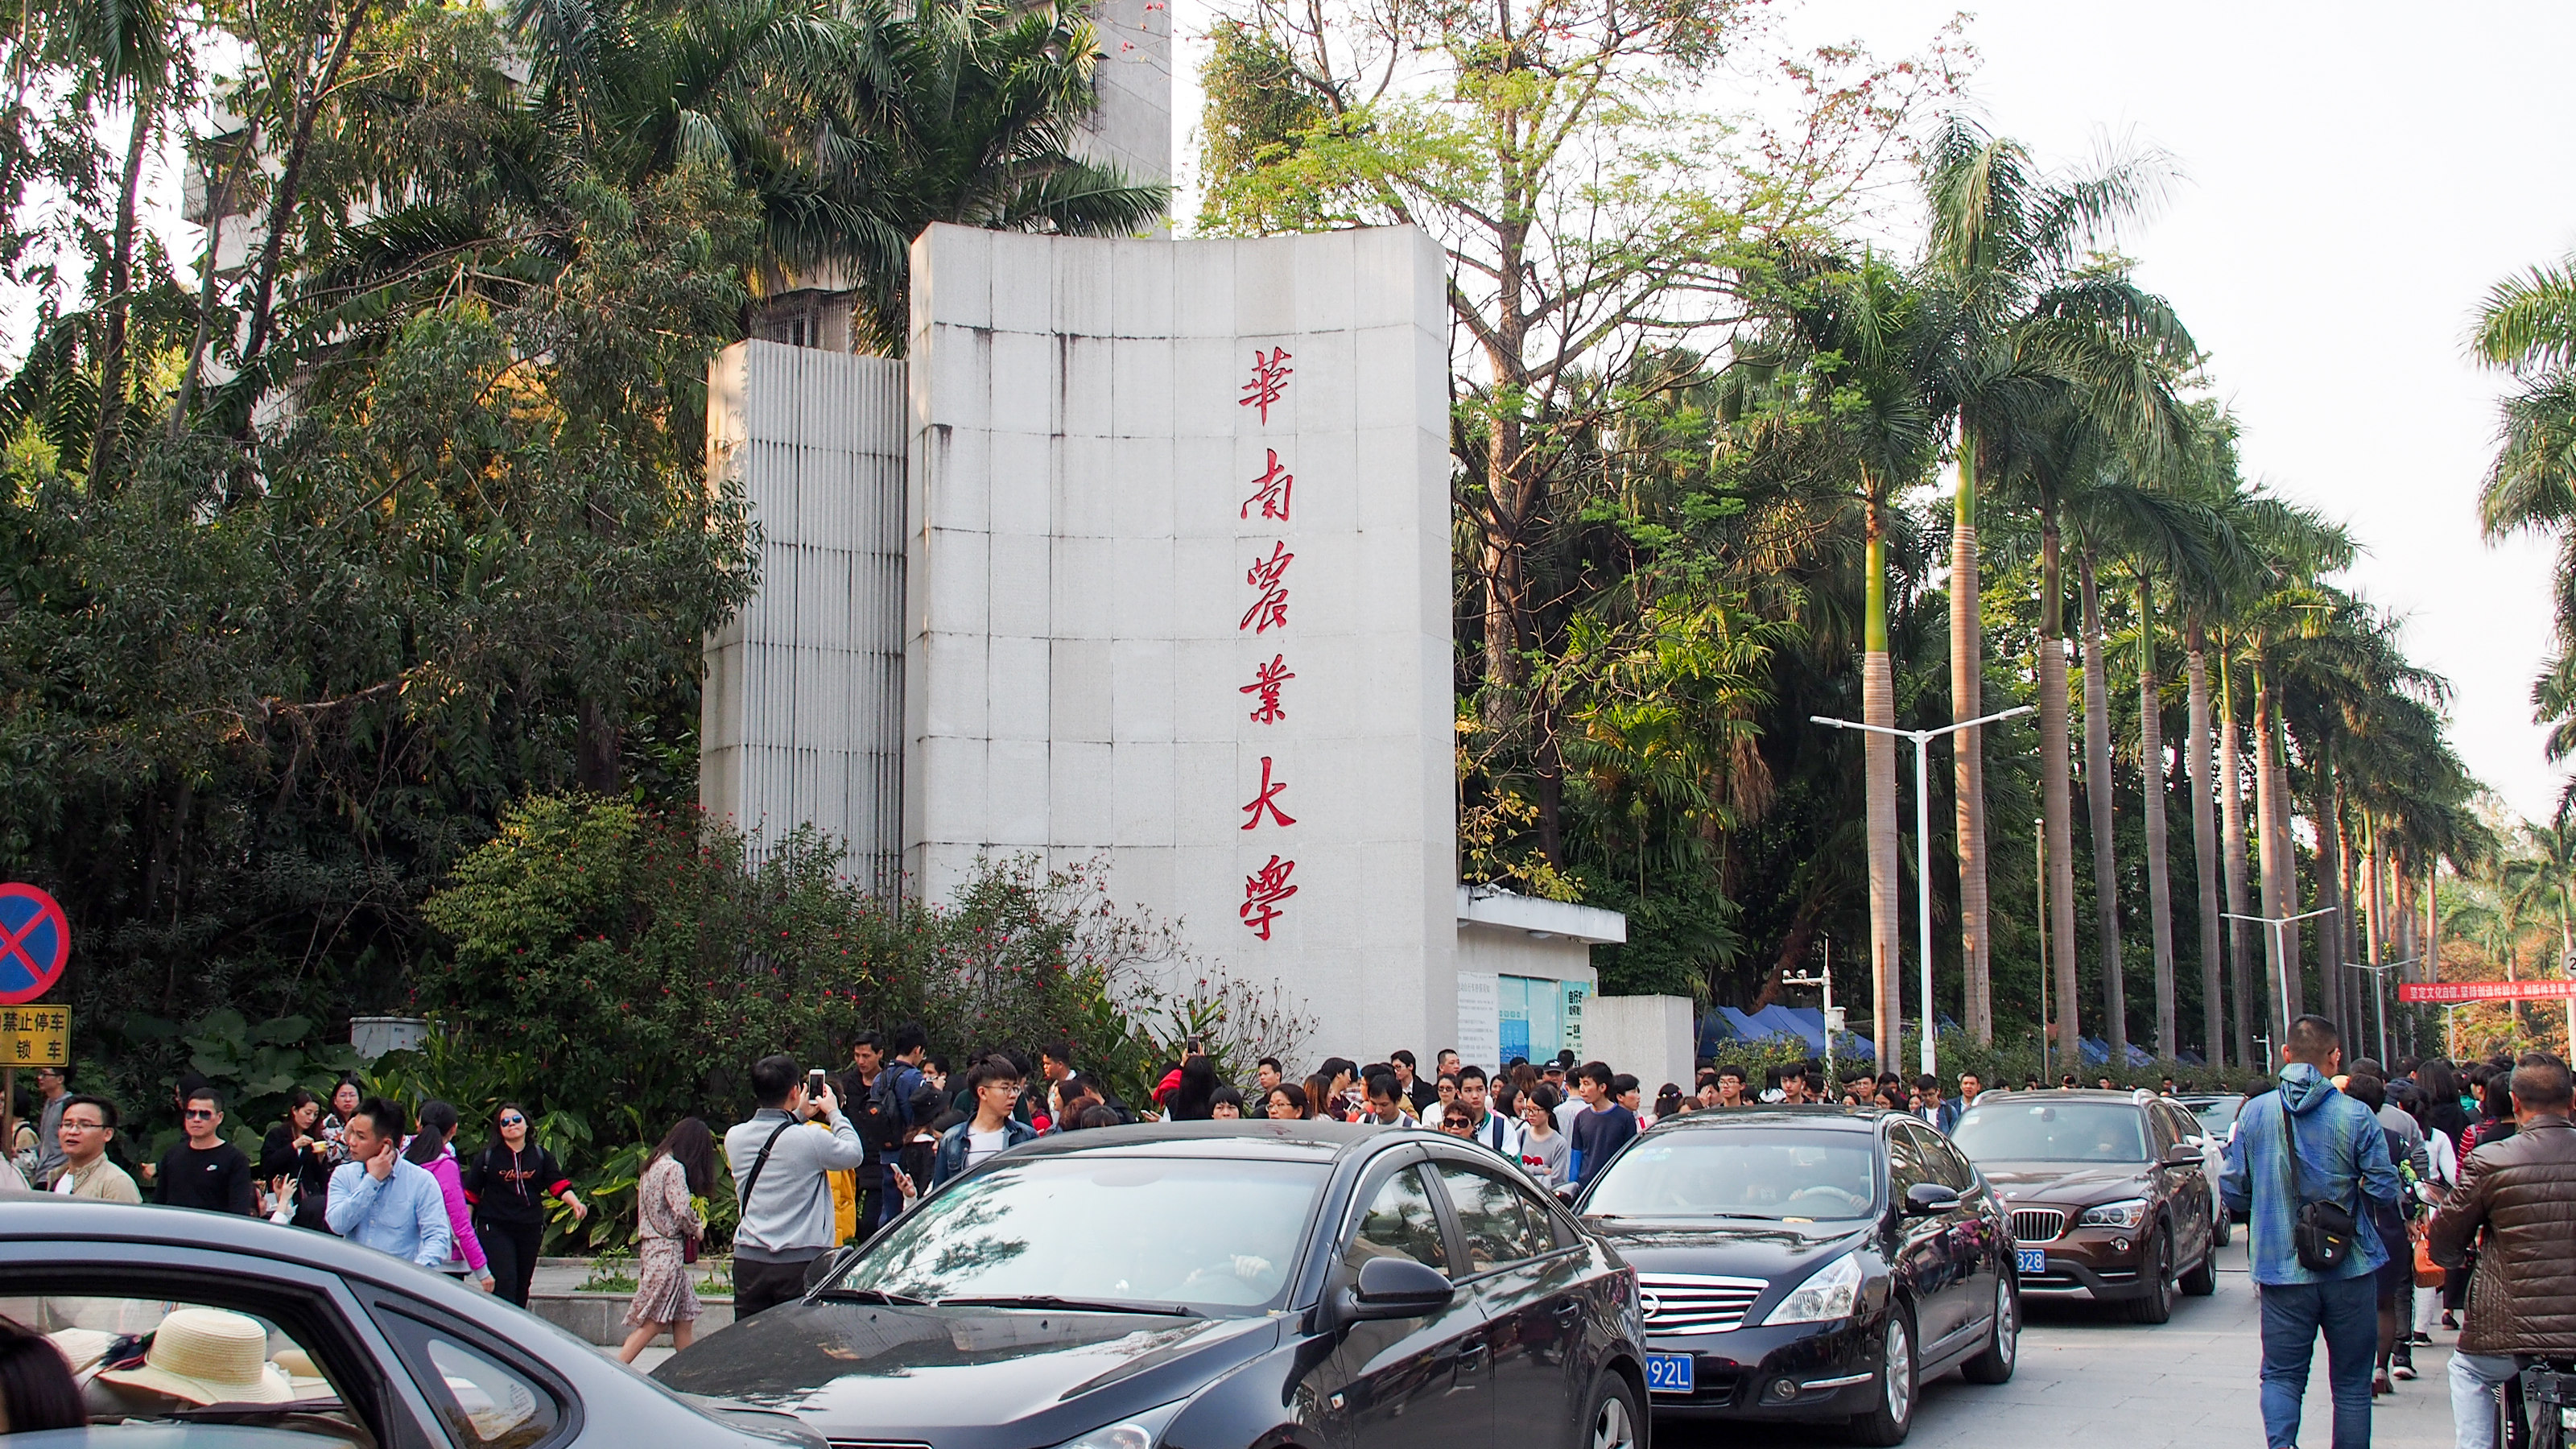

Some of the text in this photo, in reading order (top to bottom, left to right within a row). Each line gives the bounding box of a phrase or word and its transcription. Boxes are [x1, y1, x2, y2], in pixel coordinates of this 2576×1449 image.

[1239, 346, 1298, 941] 華南農業大學
[0, 1012, 64, 1032] 禁止停车
[1646, 1360, 1689, 1385] 92L
